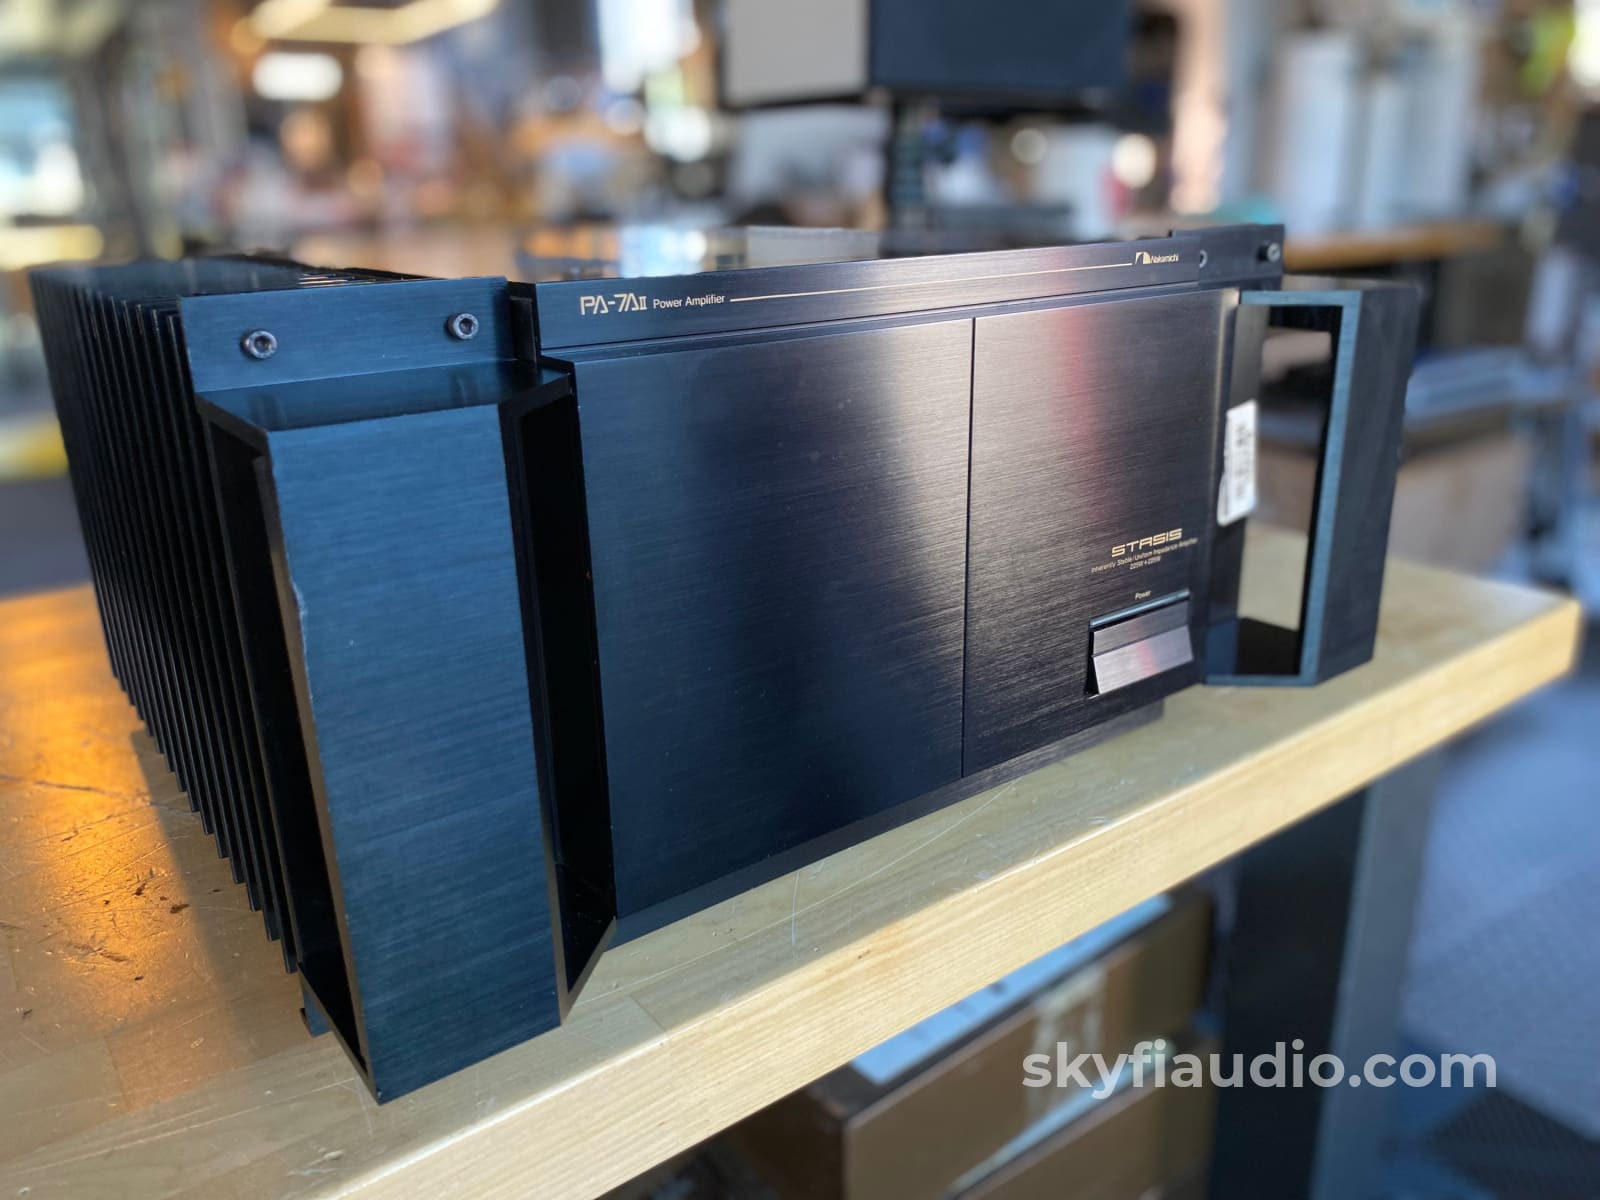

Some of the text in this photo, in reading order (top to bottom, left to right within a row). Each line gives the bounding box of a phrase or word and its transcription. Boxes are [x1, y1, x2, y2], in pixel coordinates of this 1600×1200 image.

[653, 298, 682, 309] Power
[685, 294, 726, 308] Amplifier
[1111, 527, 1182, 557] STASIS
[1134, 590, 1152, 600] Power
